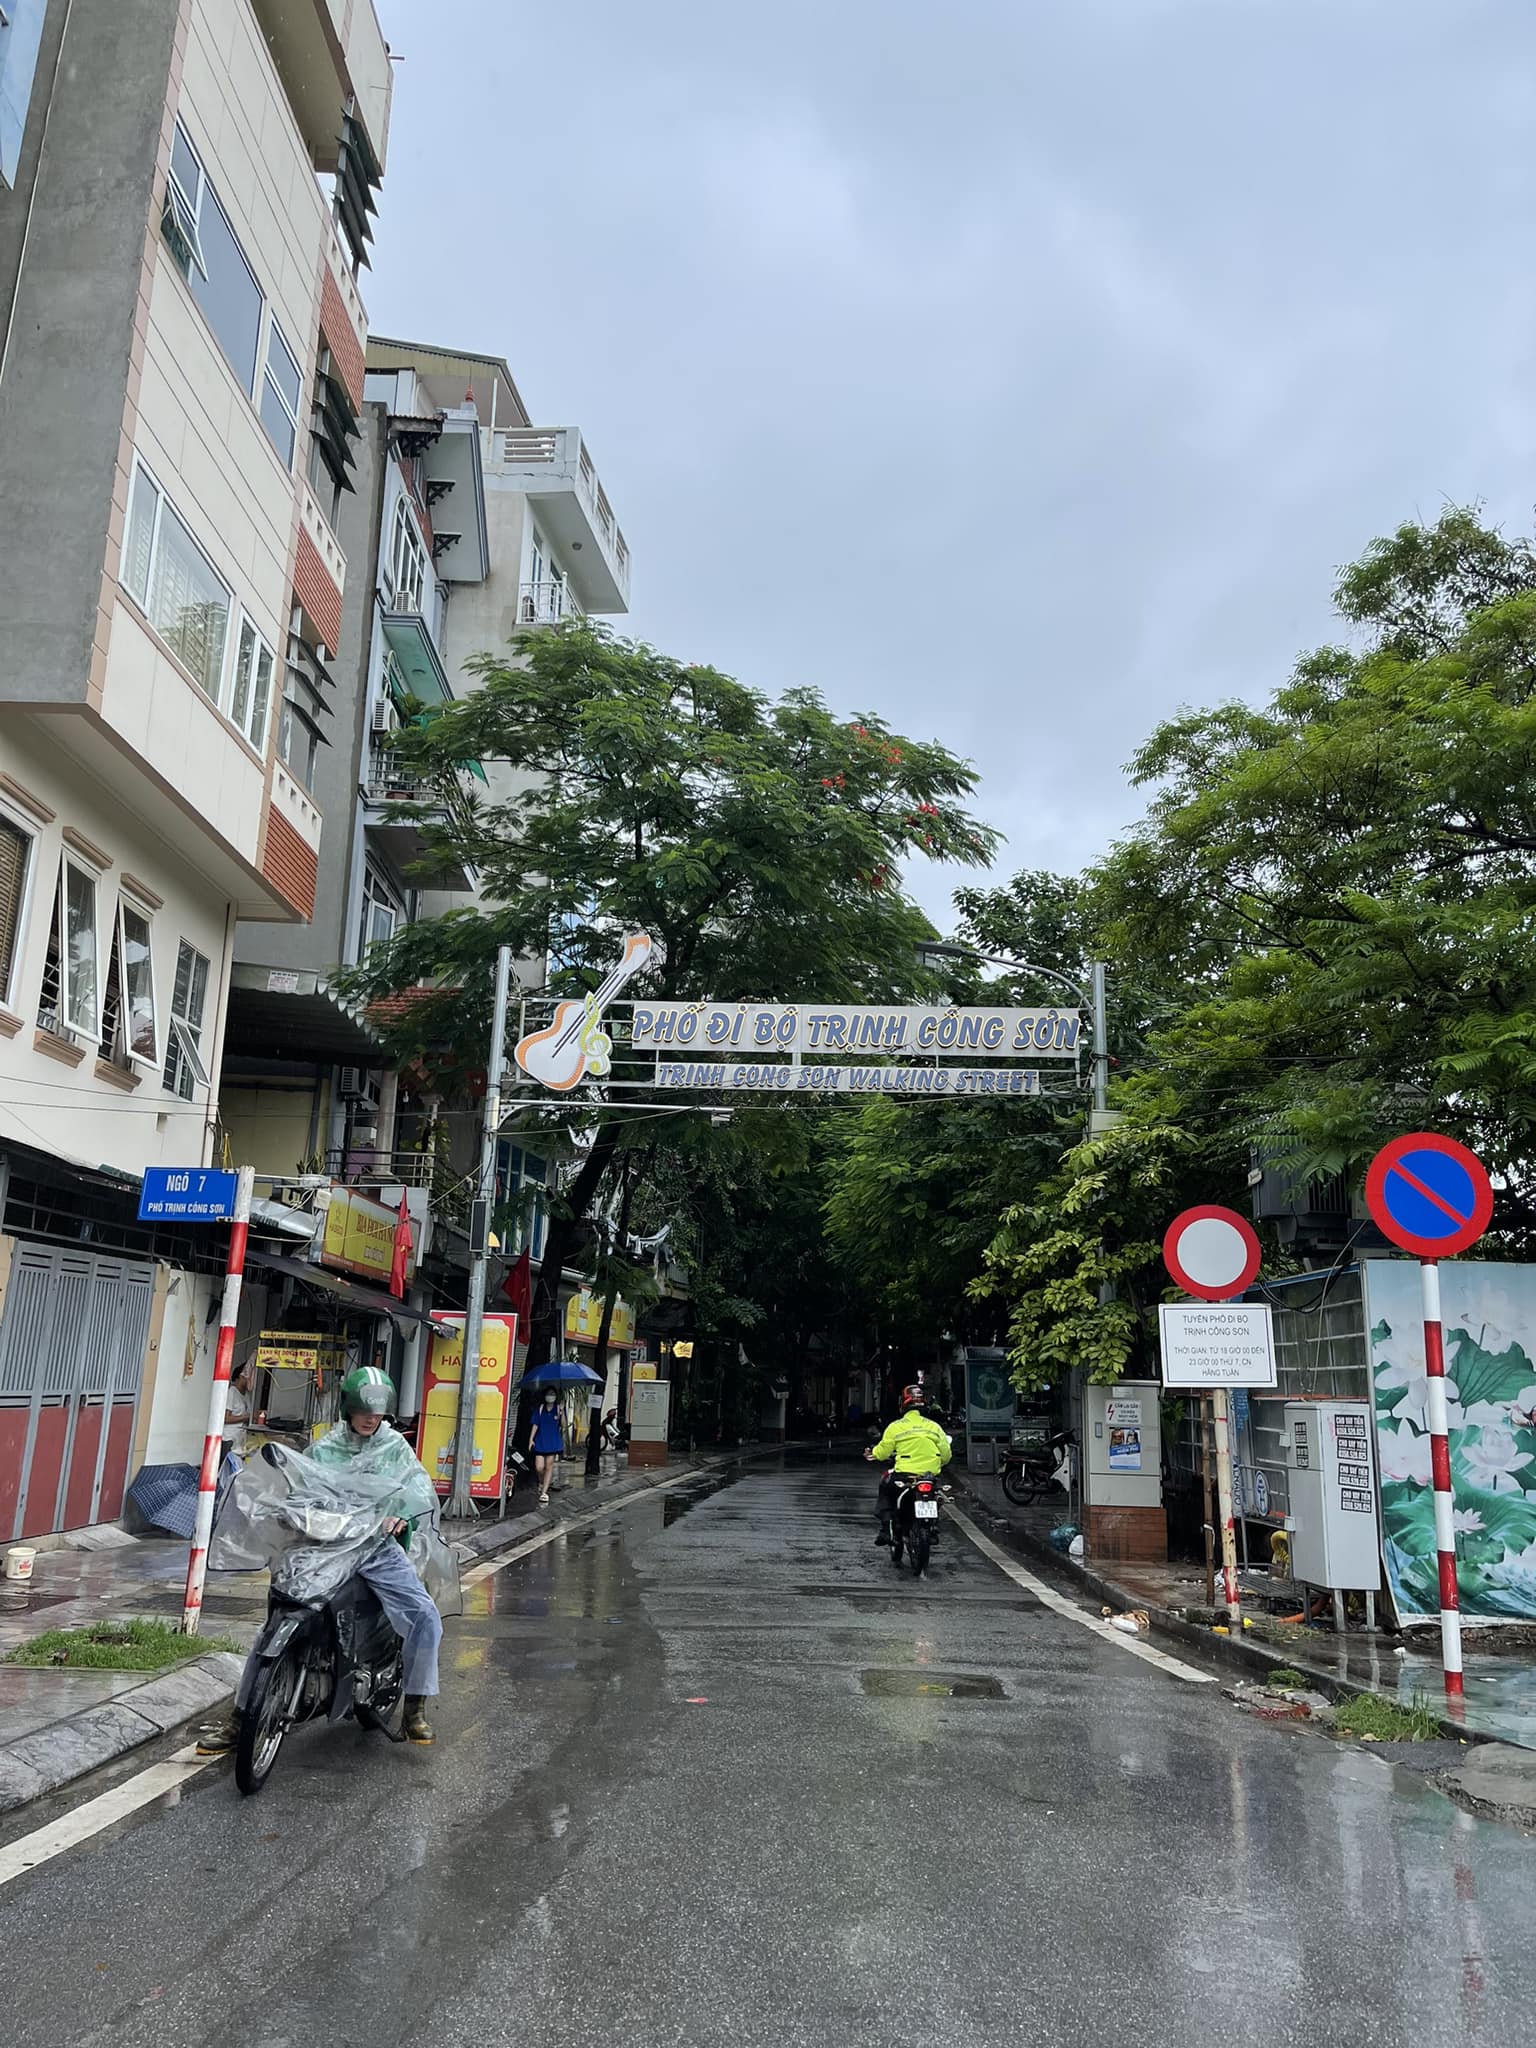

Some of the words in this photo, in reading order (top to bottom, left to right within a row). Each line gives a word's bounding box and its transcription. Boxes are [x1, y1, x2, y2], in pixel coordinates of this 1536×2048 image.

[632, 1001, 706, 1043] PHỐ
[754, 1005, 798, 1051] BỘ
[808, 1013, 908, 1053] TRỊNH
[917, 1006, 1005, 1049] CÔNG
[1012, 1009, 1081, 1050] SƠN
[659, 1064, 726, 1087] TRINH
[732, 1066, 791, 1088] CONG
[797, 1066, 841, 1089] SON
[849, 1067, 950, 1091] WALKING
[955, 1070, 1038, 1093] STREET
[166, 1172, 189, 1192] NGÕ
[198, 1175, 206, 1192] 7
[164, 1202, 186, 1216] TRỊNH
[187, 1200, 208, 1214] CÔNG
[208, 1203, 225, 1214] SƠN
[1228, 1315, 1235, 1323] ĐI
[1208, 1326, 1231, 1336] CÔNG
[441, 1355, 497, 1368] HACO
[1242, 1358, 1252, 1366] CN
